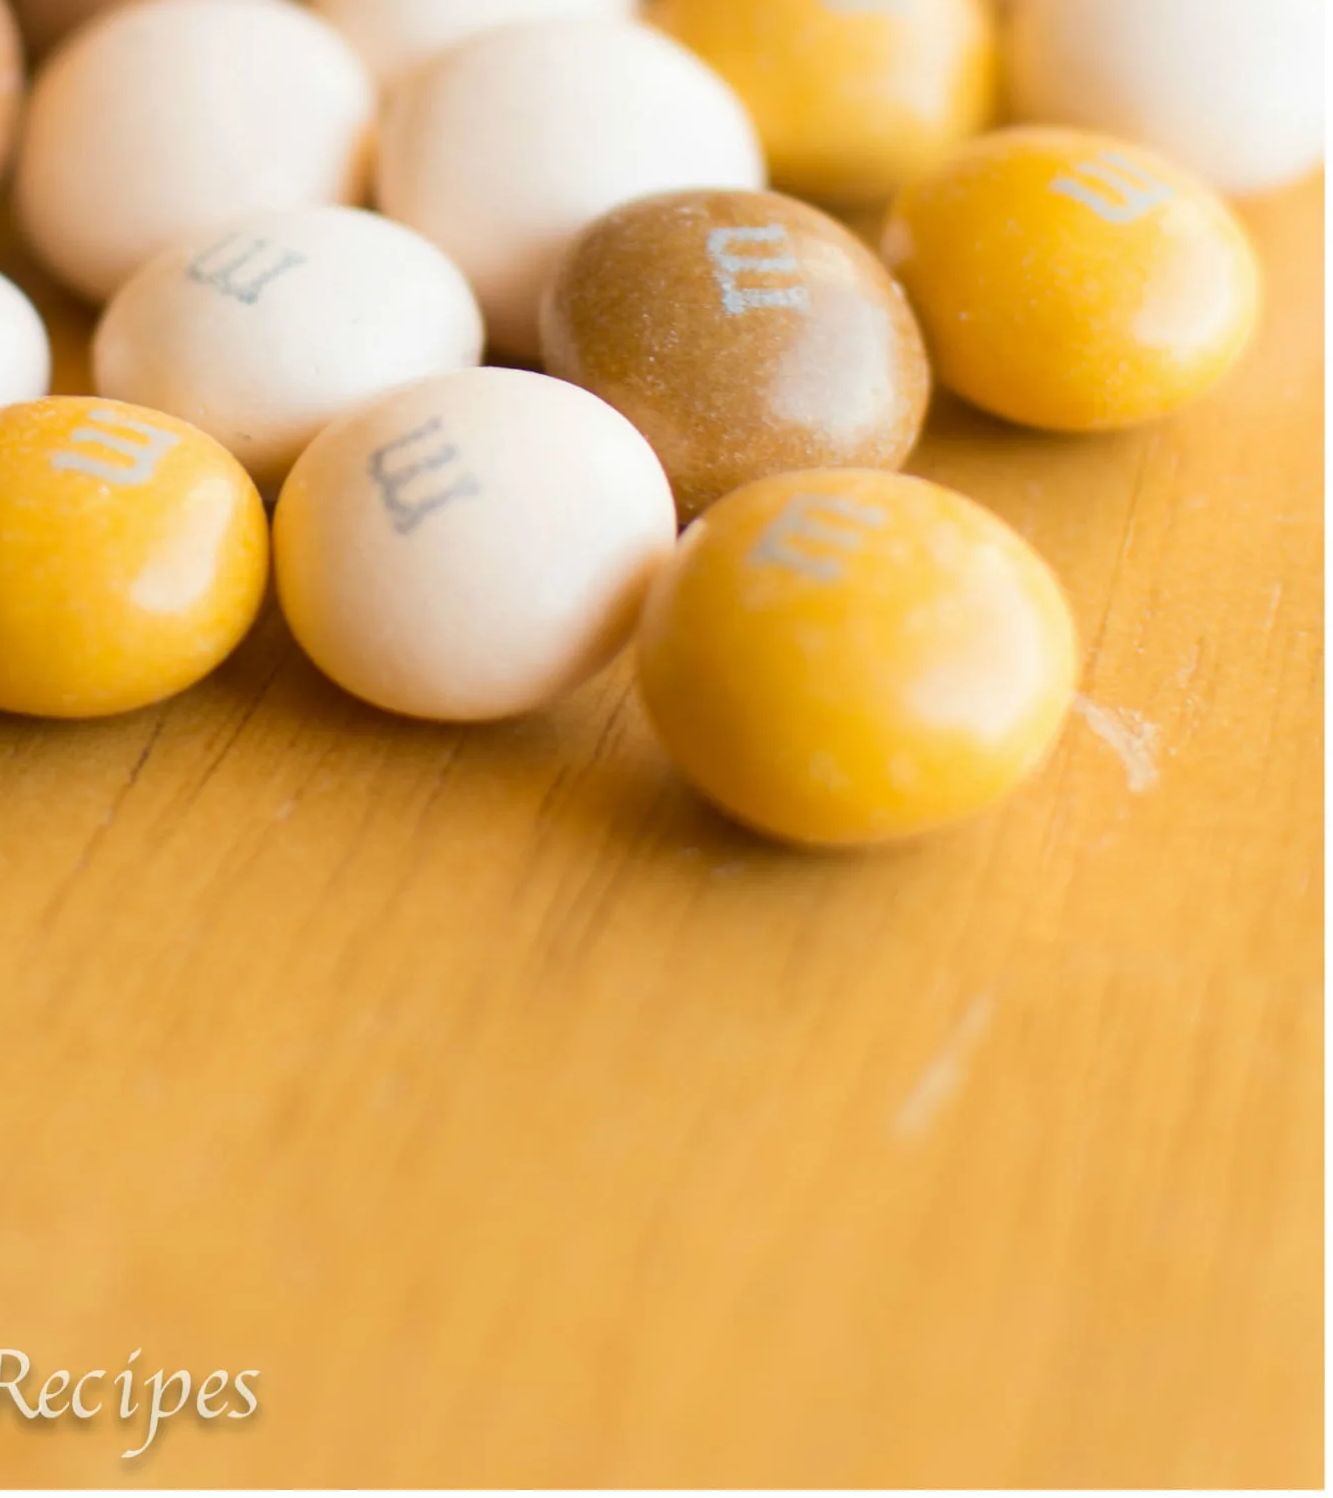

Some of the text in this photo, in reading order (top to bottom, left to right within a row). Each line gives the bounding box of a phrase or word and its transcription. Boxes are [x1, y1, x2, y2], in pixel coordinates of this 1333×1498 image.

[1052, 152, 1175, 223] m
[708, 225, 807, 312] m
[50, 410, 179, 484] m
[368, 416, 480, 535] m
[751, 494, 888, 584] m
